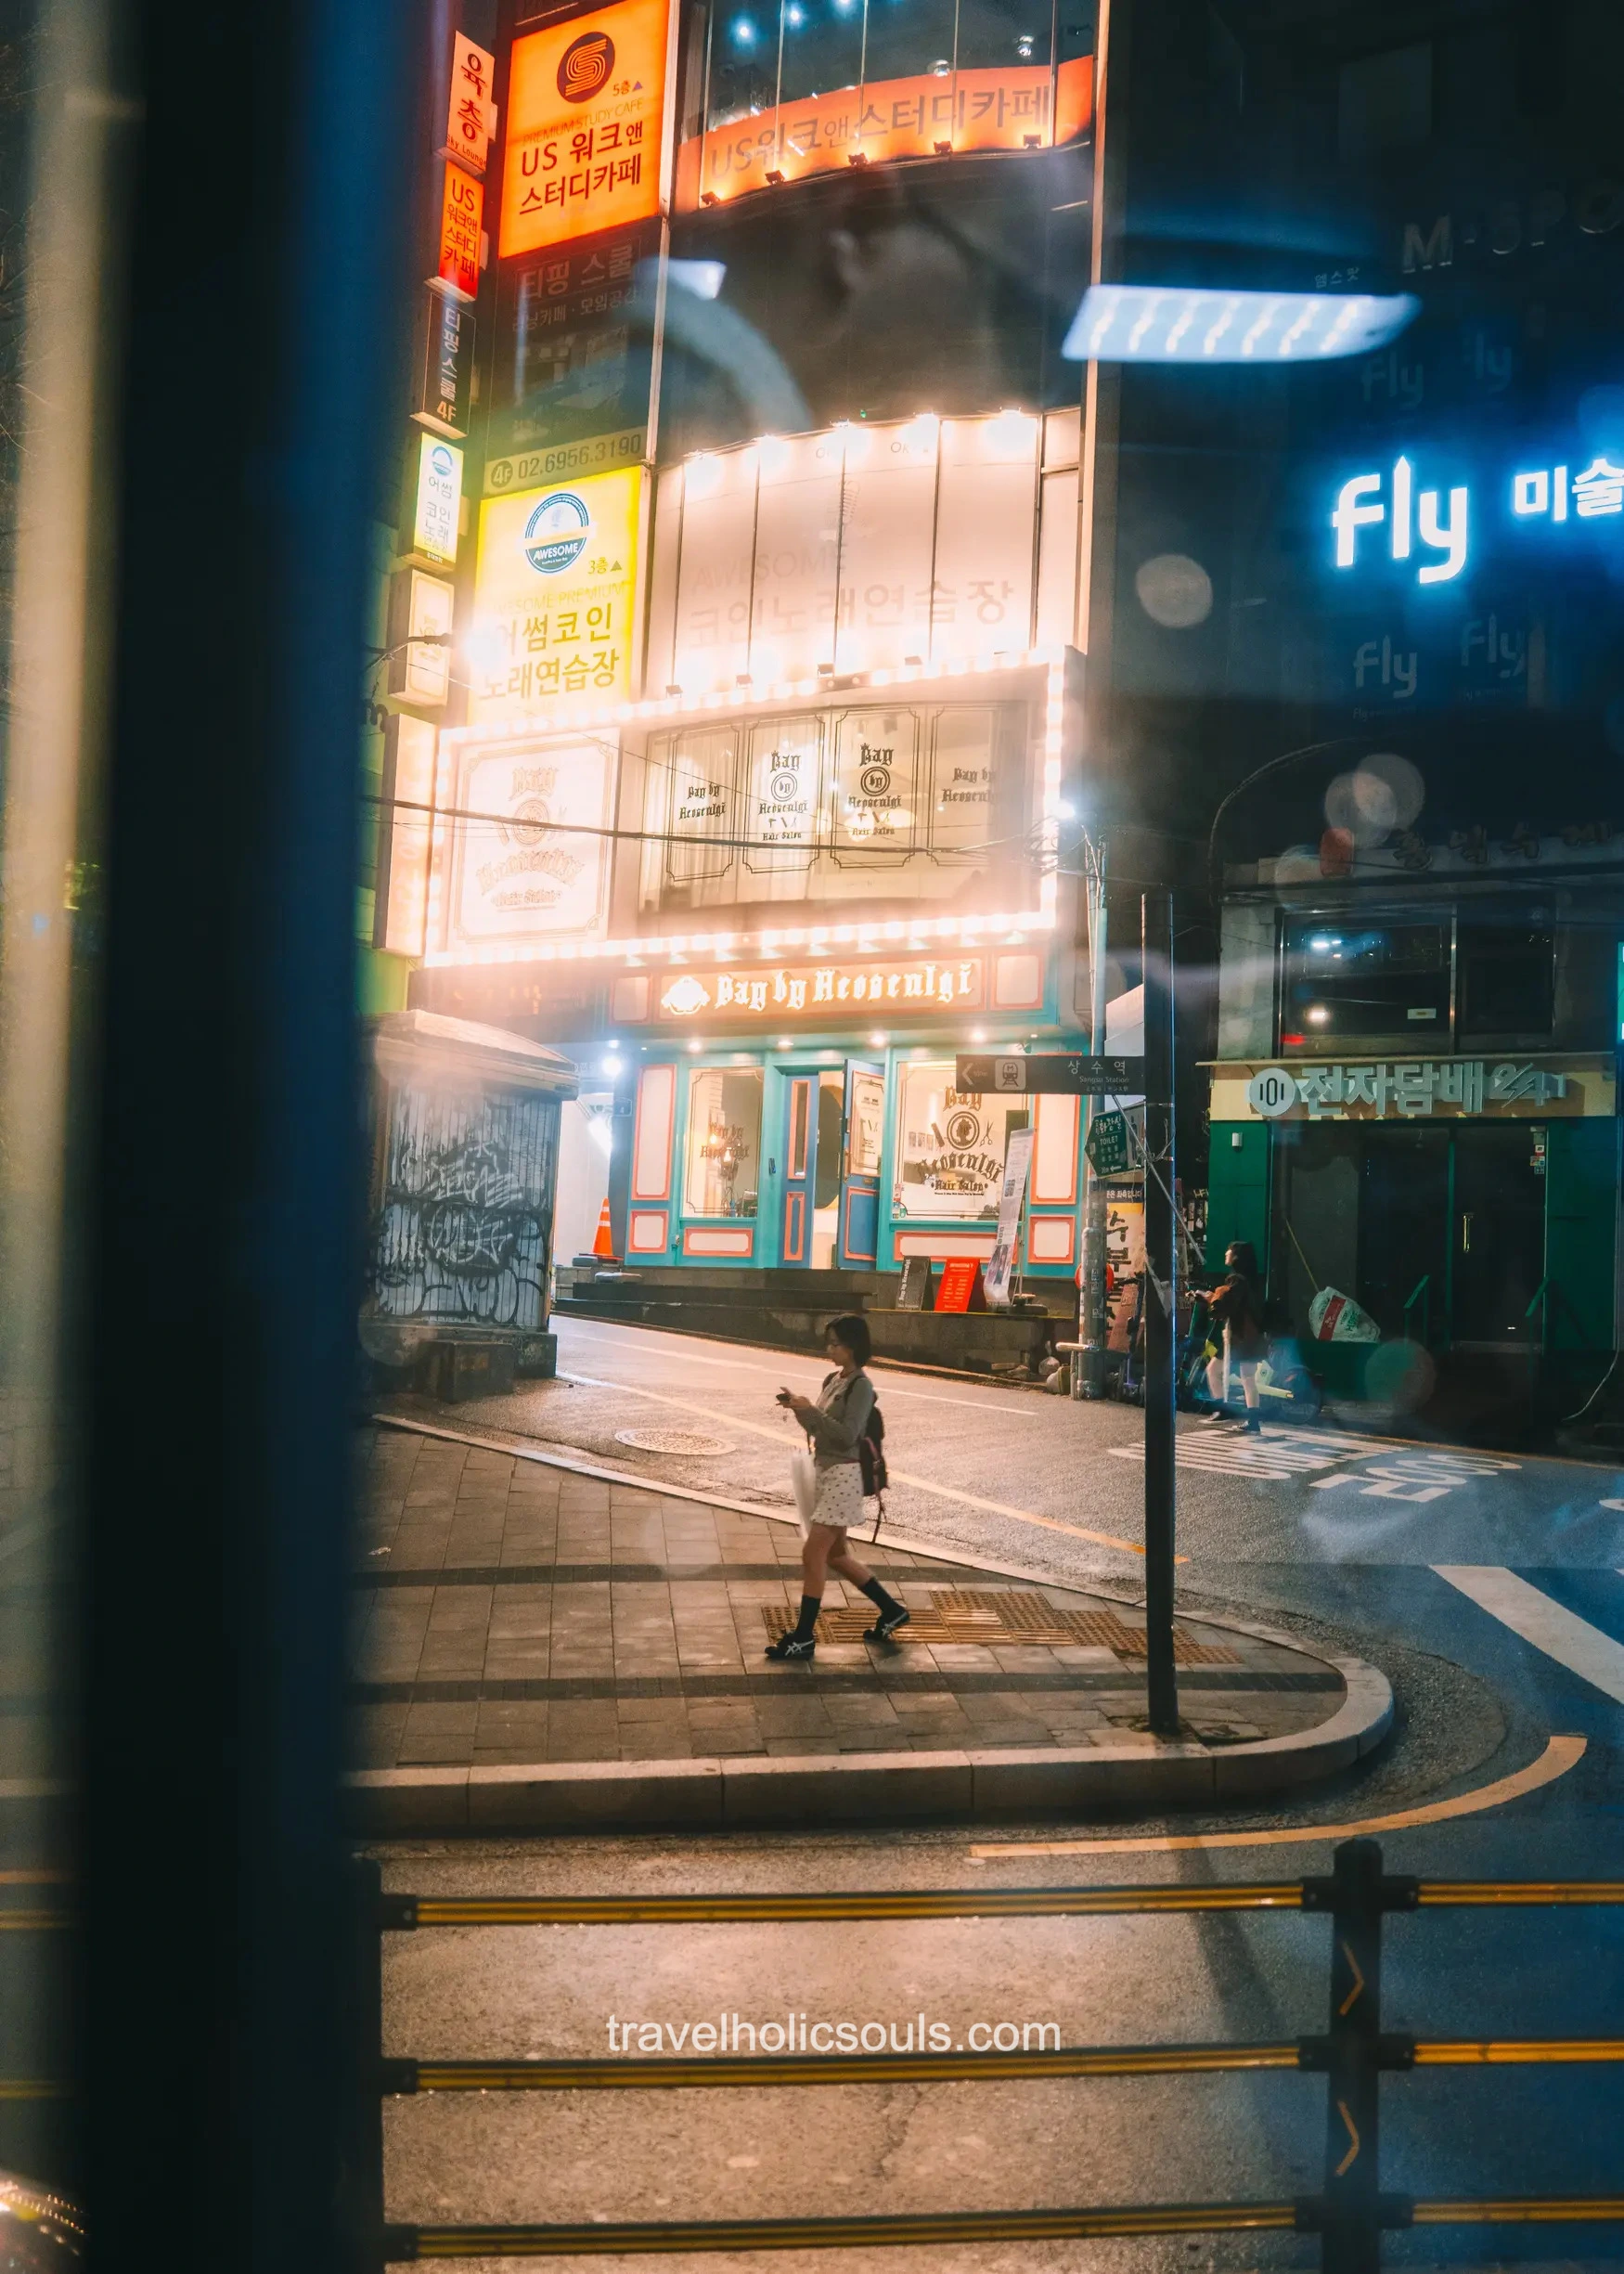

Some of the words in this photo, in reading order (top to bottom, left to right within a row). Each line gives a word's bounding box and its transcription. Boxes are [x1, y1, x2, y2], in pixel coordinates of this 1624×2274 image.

[458, 53, 488, 143] 육층
[612, 82, 631, 97] 5층
[522, 119, 575, 145] PREMIUM
[575, 107, 614, 132] STUDY
[614, 97, 643, 116] CAFE
[522, 141, 557, 176] US
[569, 121, 643, 163] 워크앤
[452, 178, 475, 213] US
[520, 153, 641, 215] 스터디카페
[444, 246, 475, 282] 카페
[437, 400, 458, 422] 4F
[493, 464, 511, 485] 4F
[518, 433, 641, 479] 02.6956.3190
[1332, 455, 1469, 584] fly
[533, 542, 579, 562] AWESOME
[586, 557, 608, 575] 3층
[482, 648, 619, 699] 노래연습장
[714, 973, 768, 1012] Bay
[772, 969, 808, 1010] by
[1067, 1059, 1127, 1076] 상수역
[1301, 1062, 1484, 1116] 전자담배
[1100, 1135, 1118, 1145] TOILET
